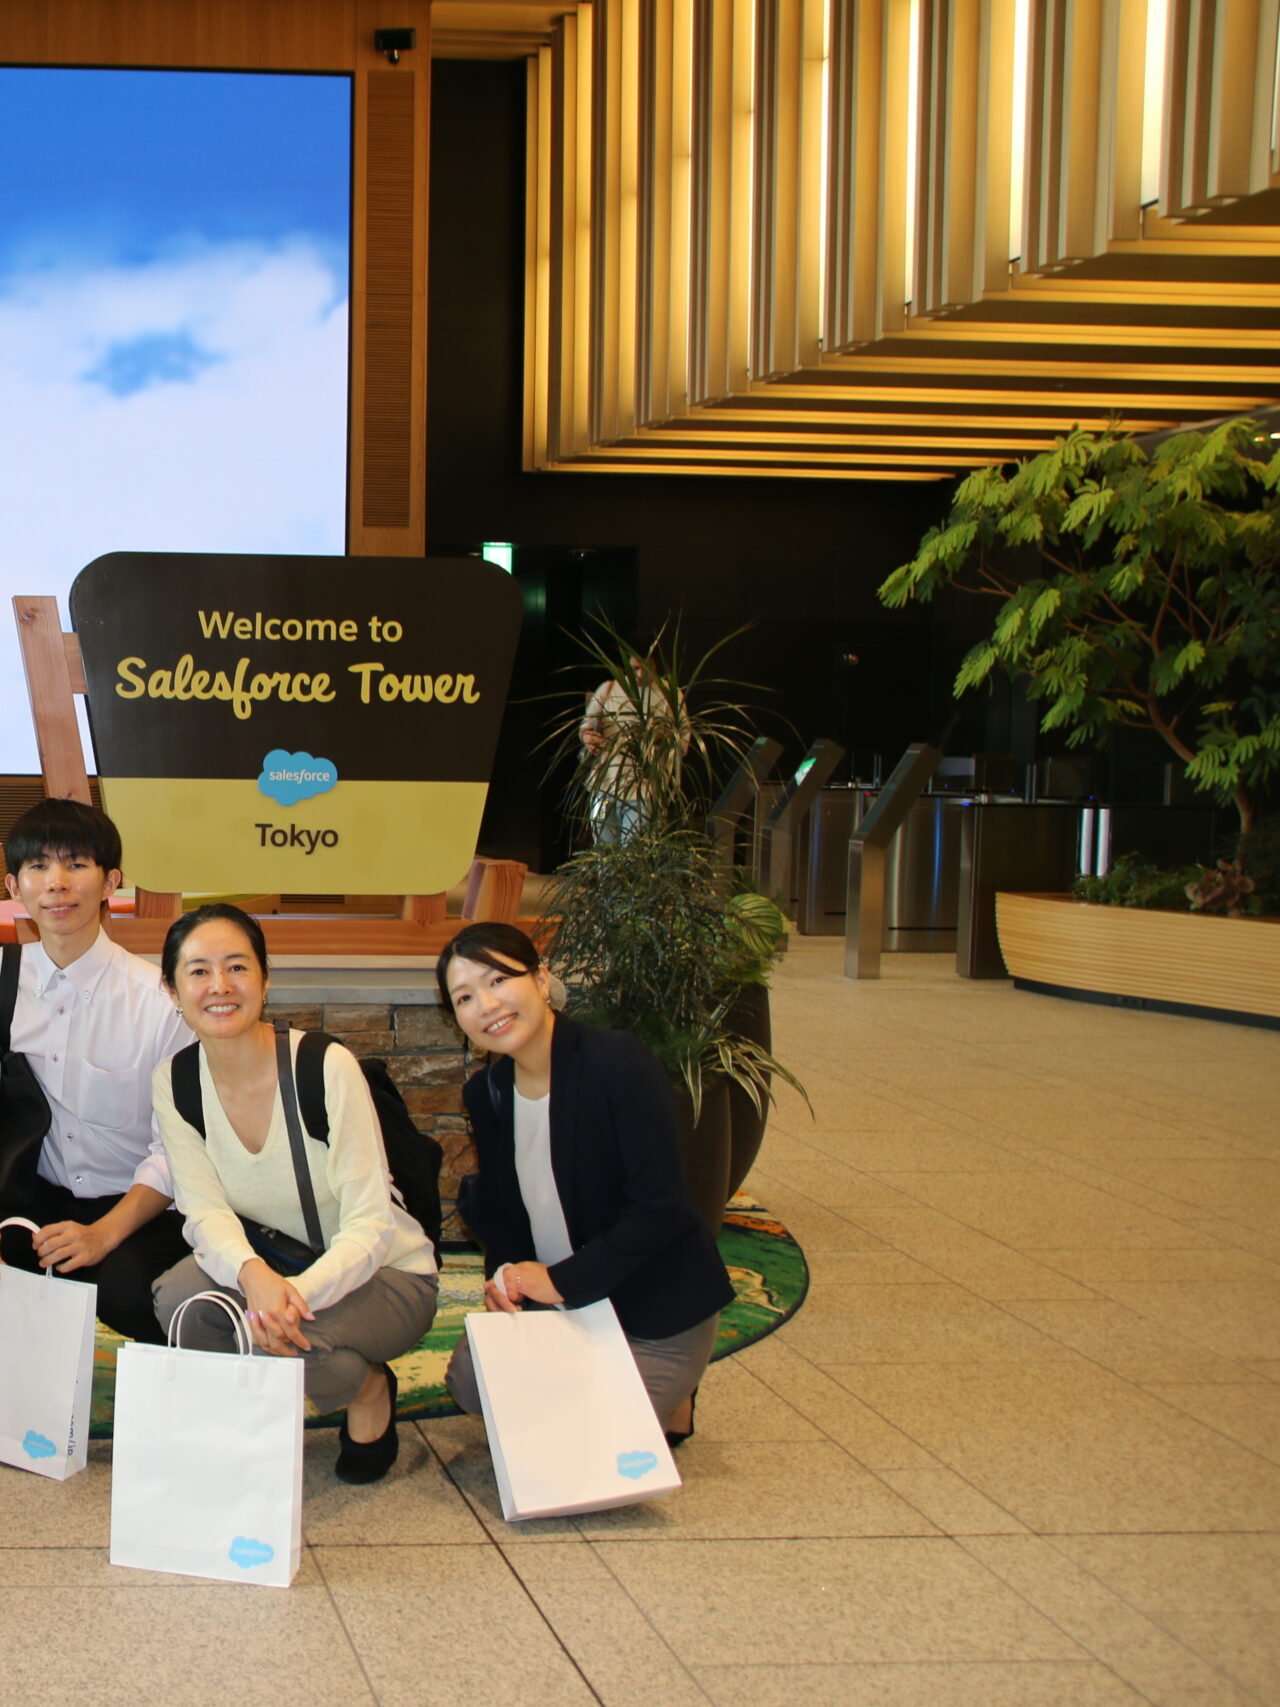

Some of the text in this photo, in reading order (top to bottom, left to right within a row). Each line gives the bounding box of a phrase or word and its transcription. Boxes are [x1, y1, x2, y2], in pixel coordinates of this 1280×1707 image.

[197, 610, 403, 643] Welcome to
[115, 653, 481, 720] Salesforce Tower
[269, 768, 331, 785] salesforce
[254, 823, 339, 855] Tokyo
